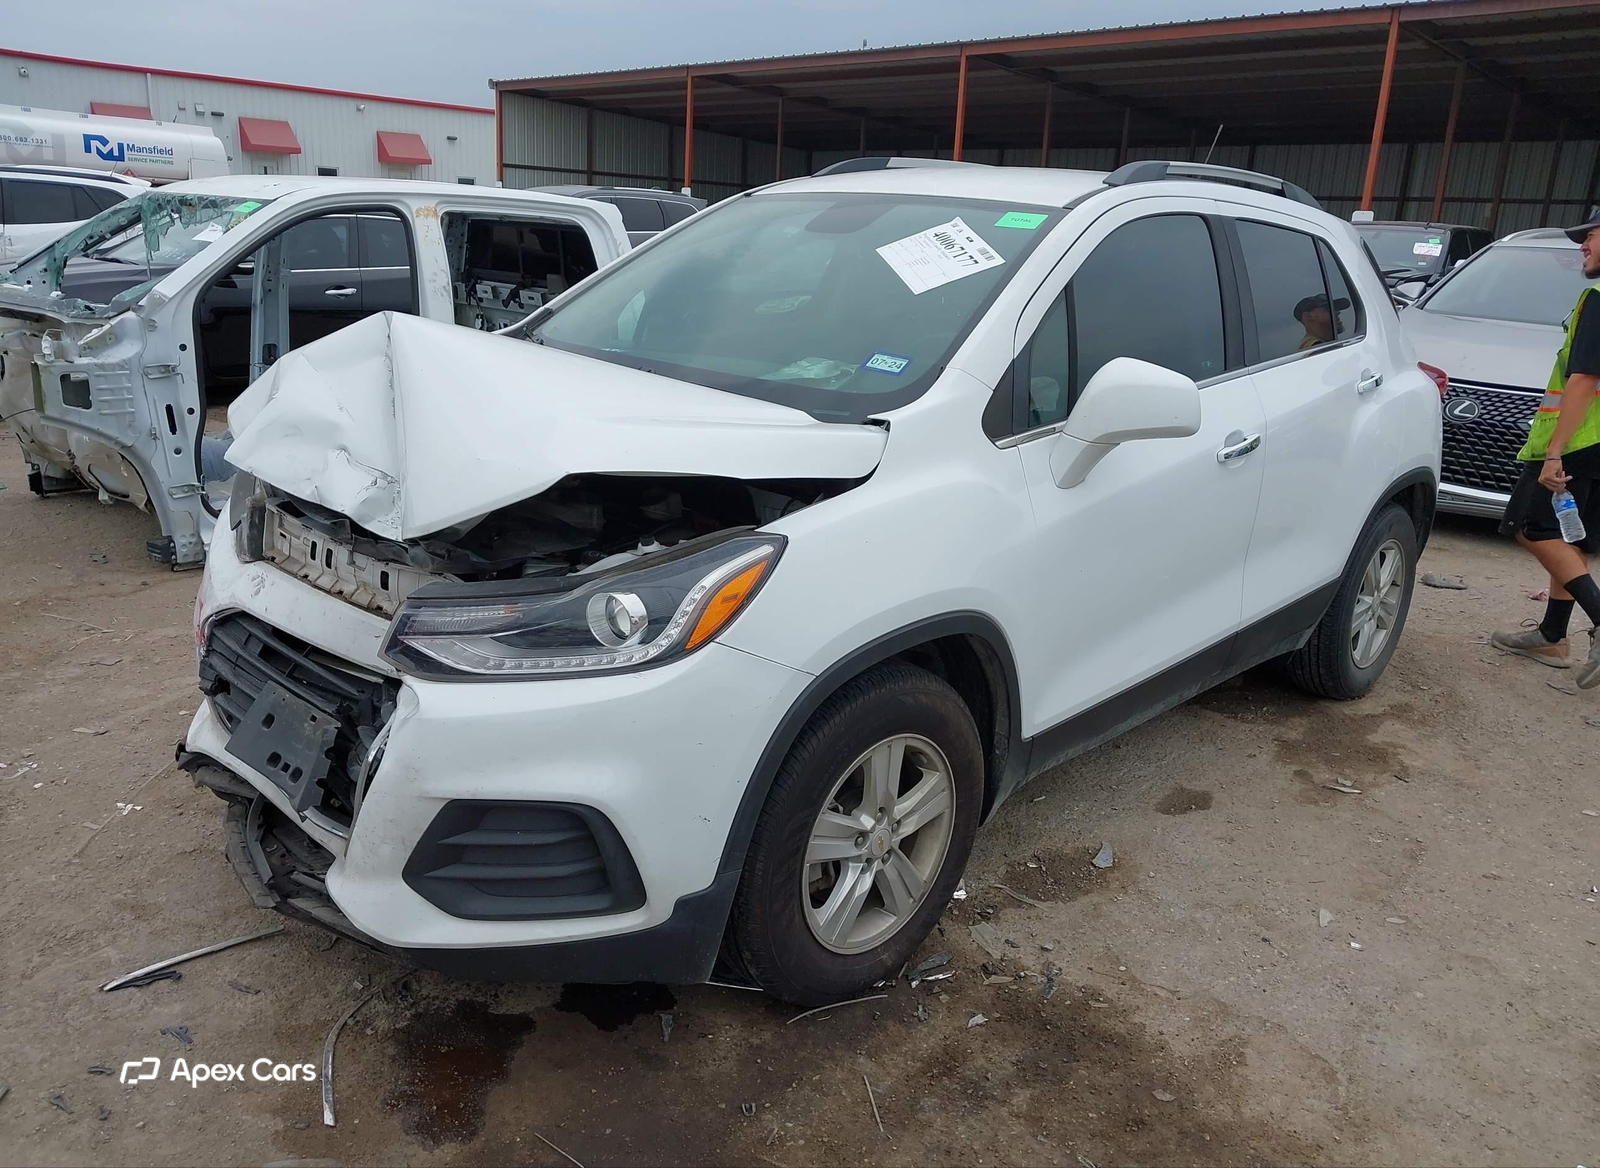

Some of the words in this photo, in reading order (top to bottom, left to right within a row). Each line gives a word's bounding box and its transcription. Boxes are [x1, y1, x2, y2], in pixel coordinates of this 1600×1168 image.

[126, 143, 174, 156] Mansfield
[149, 158, 174, 166] PARTNERS
[932, 230, 980, 268] 40067177
